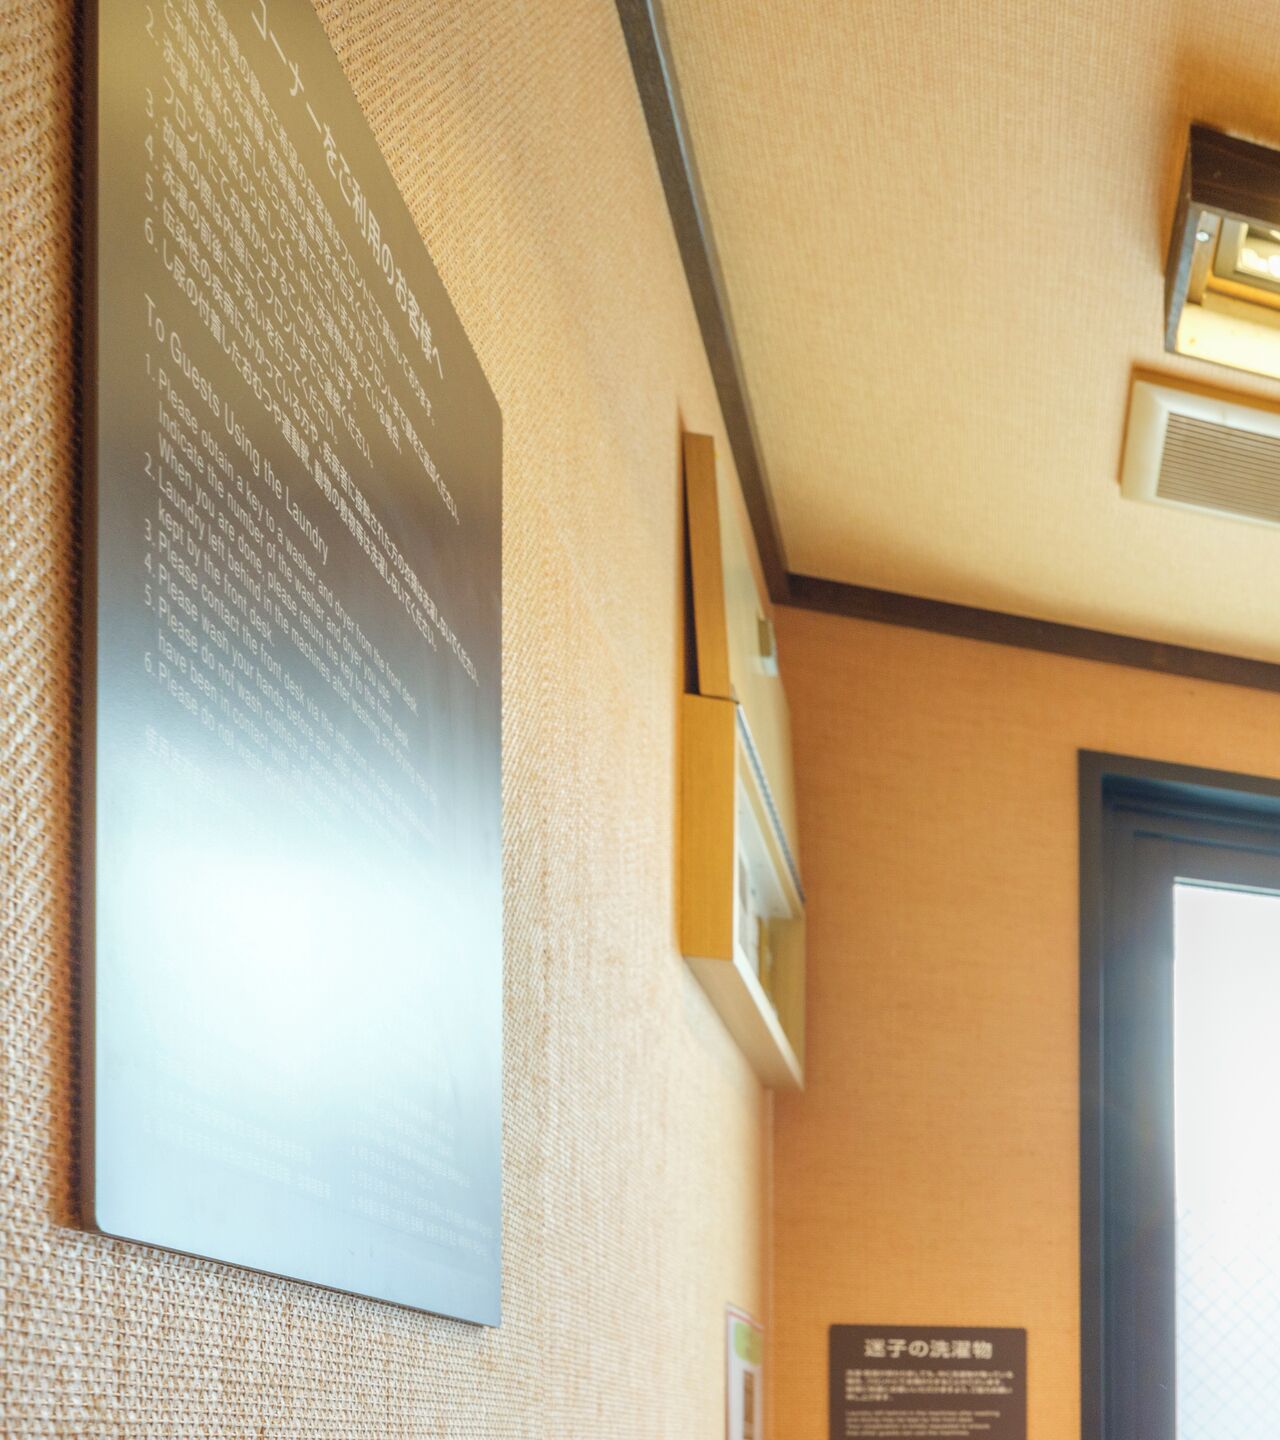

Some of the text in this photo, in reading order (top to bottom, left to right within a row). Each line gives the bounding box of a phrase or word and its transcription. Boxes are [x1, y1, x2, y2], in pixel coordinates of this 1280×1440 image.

[145, 291, 328, 571] To Guests Using the Laundry
[158, 364, 197, 437] Please
[202, 421, 233, 483] obtain
[247, 480, 261, 524] key
[266, 507, 274, 535] to
[285, 531, 315, 587] washer
[318, 574, 332, 609] and
[335, 596, 353, 640] dryer
[356, 623, 371, 658] from
[373, 644, 384, 674] the
[386, 661, 401, 696] front
[864, 1338, 993, 1359] 迷子の洗濯物
